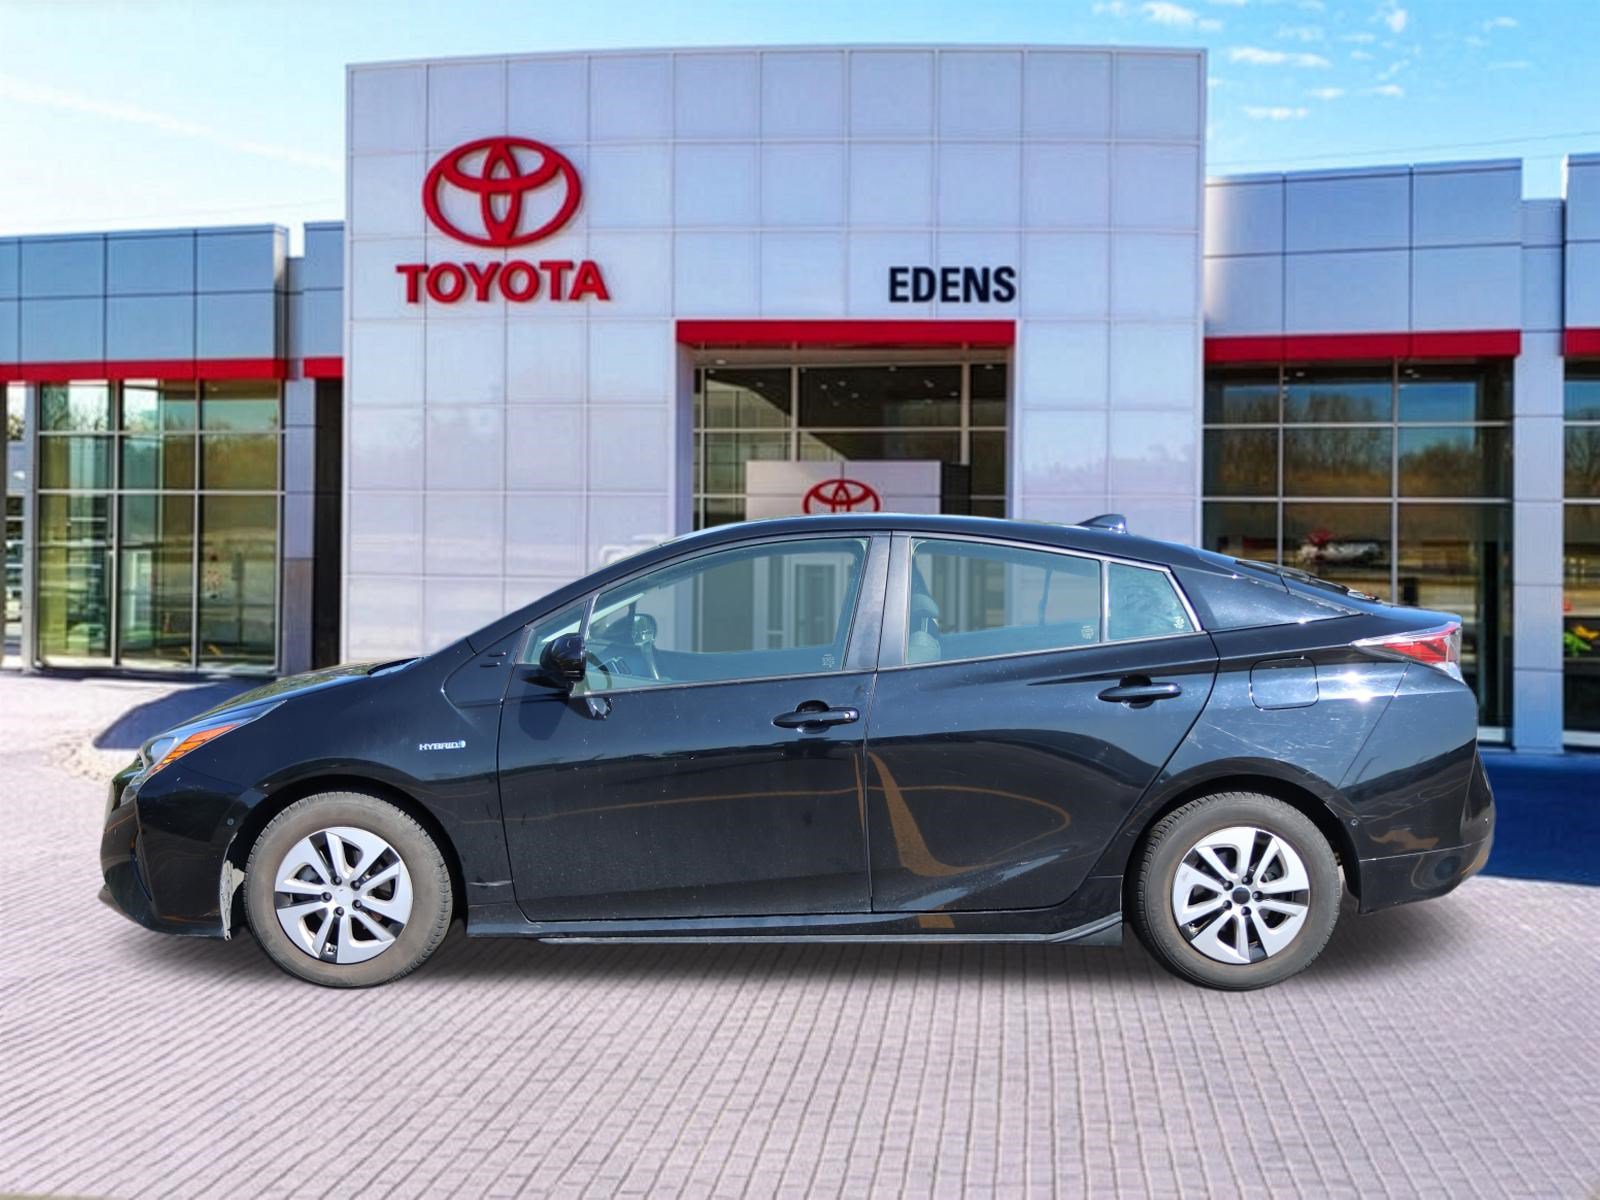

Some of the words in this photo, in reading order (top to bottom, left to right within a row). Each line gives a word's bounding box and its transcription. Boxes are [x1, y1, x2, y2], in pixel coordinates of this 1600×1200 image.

[396, 259, 610, 304] TOYOTA
[889, 266, 1017, 303] EDENS
[419, 741, 460, 751] HYBRID
